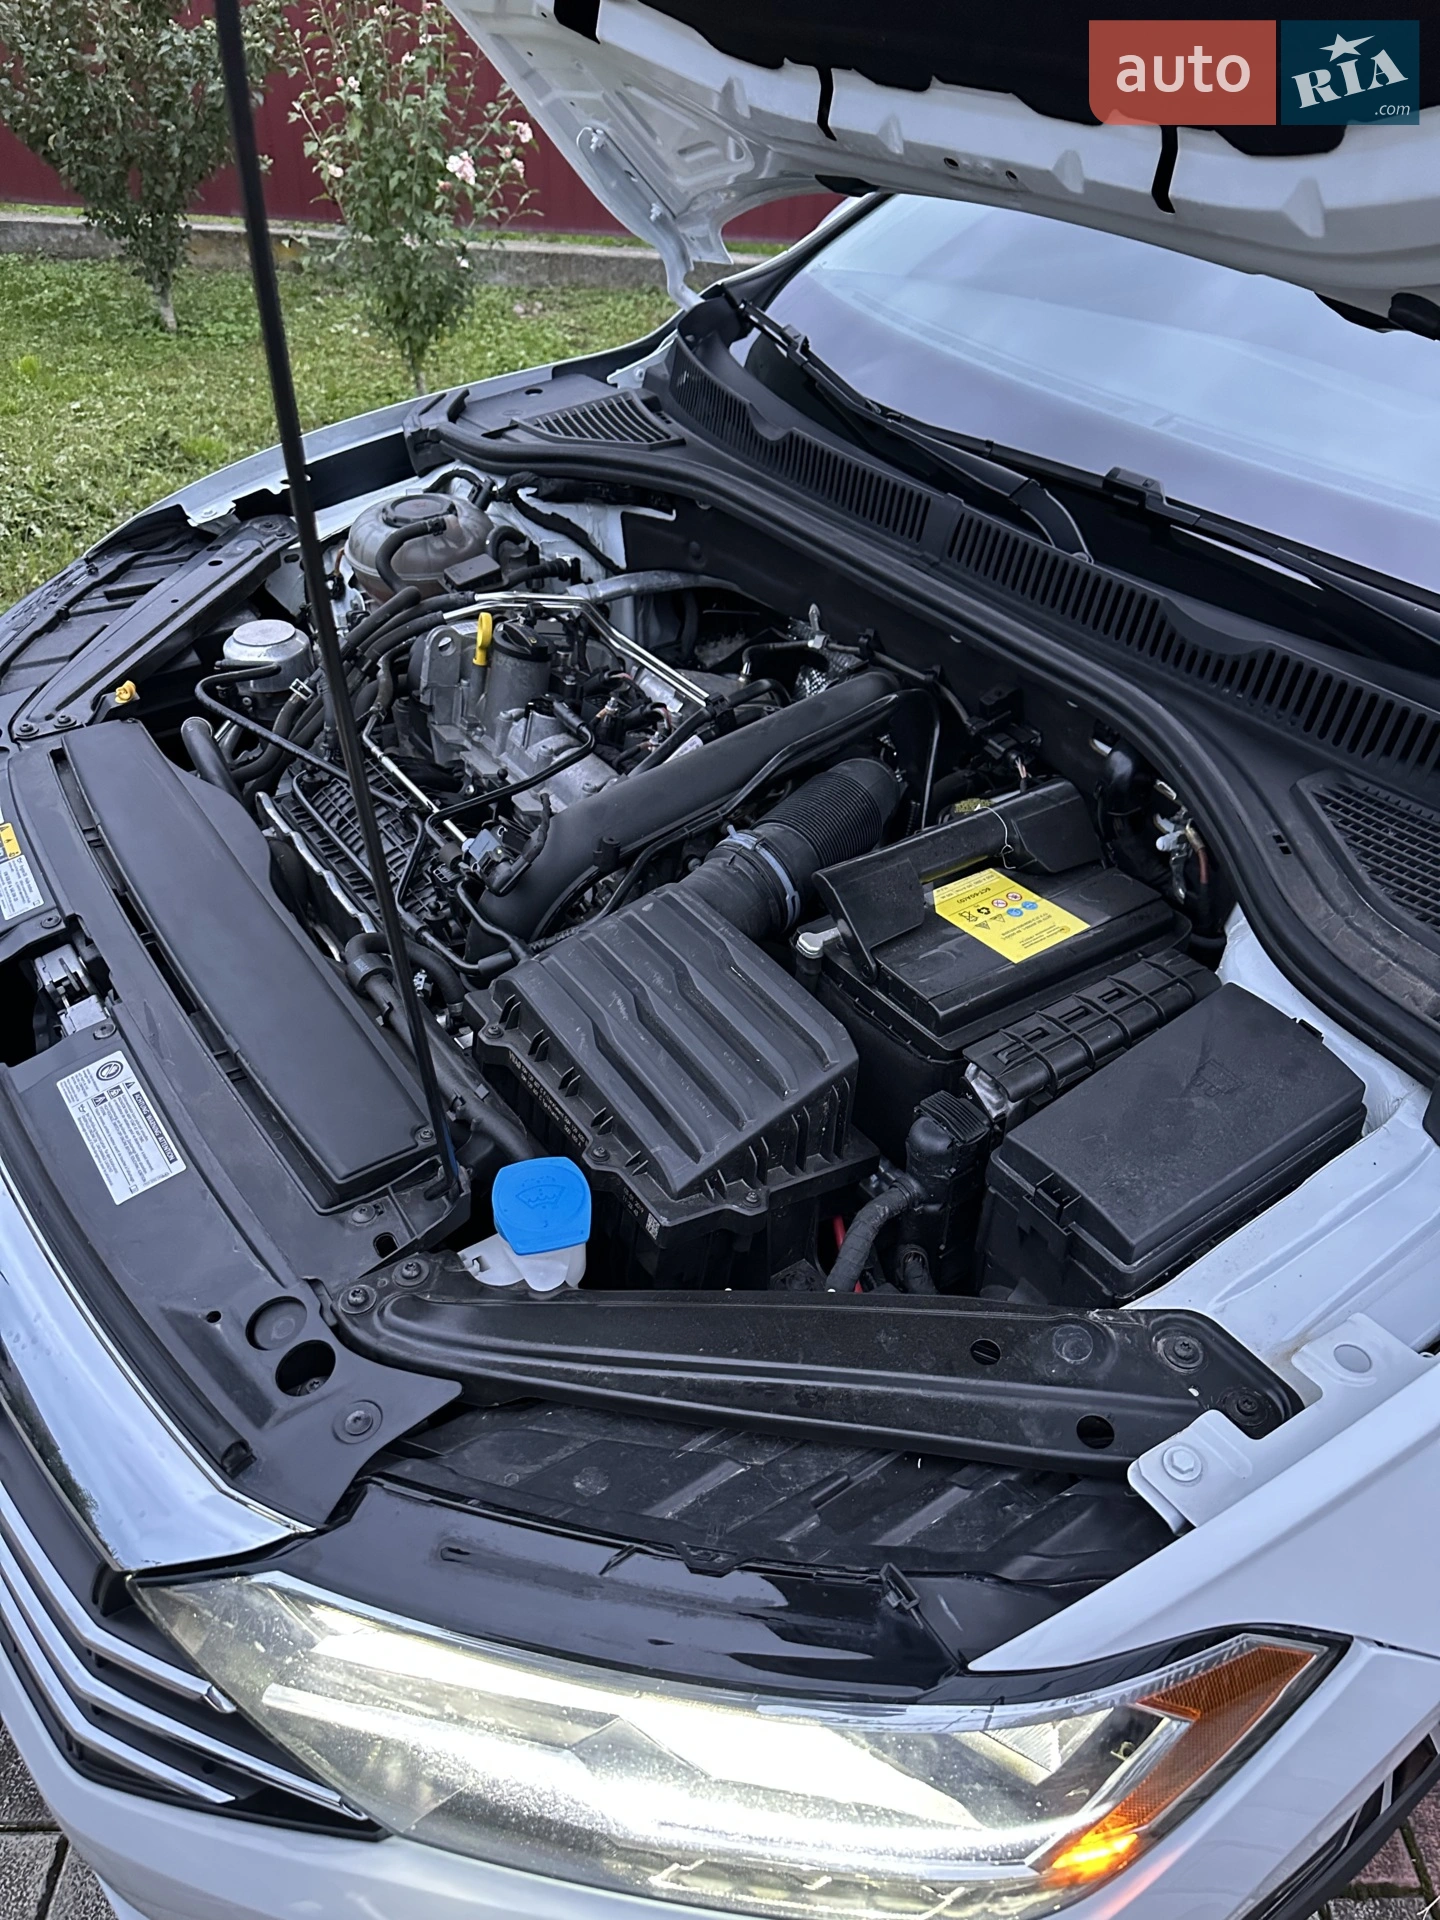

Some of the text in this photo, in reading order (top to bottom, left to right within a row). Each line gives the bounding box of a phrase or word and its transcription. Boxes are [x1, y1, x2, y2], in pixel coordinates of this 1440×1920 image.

[134, 1093, 149, 1115] ACHTUNG
[146, 1114, 161, 1137] WARNING
[157, 1136, 176, 1161] ATTENTION
